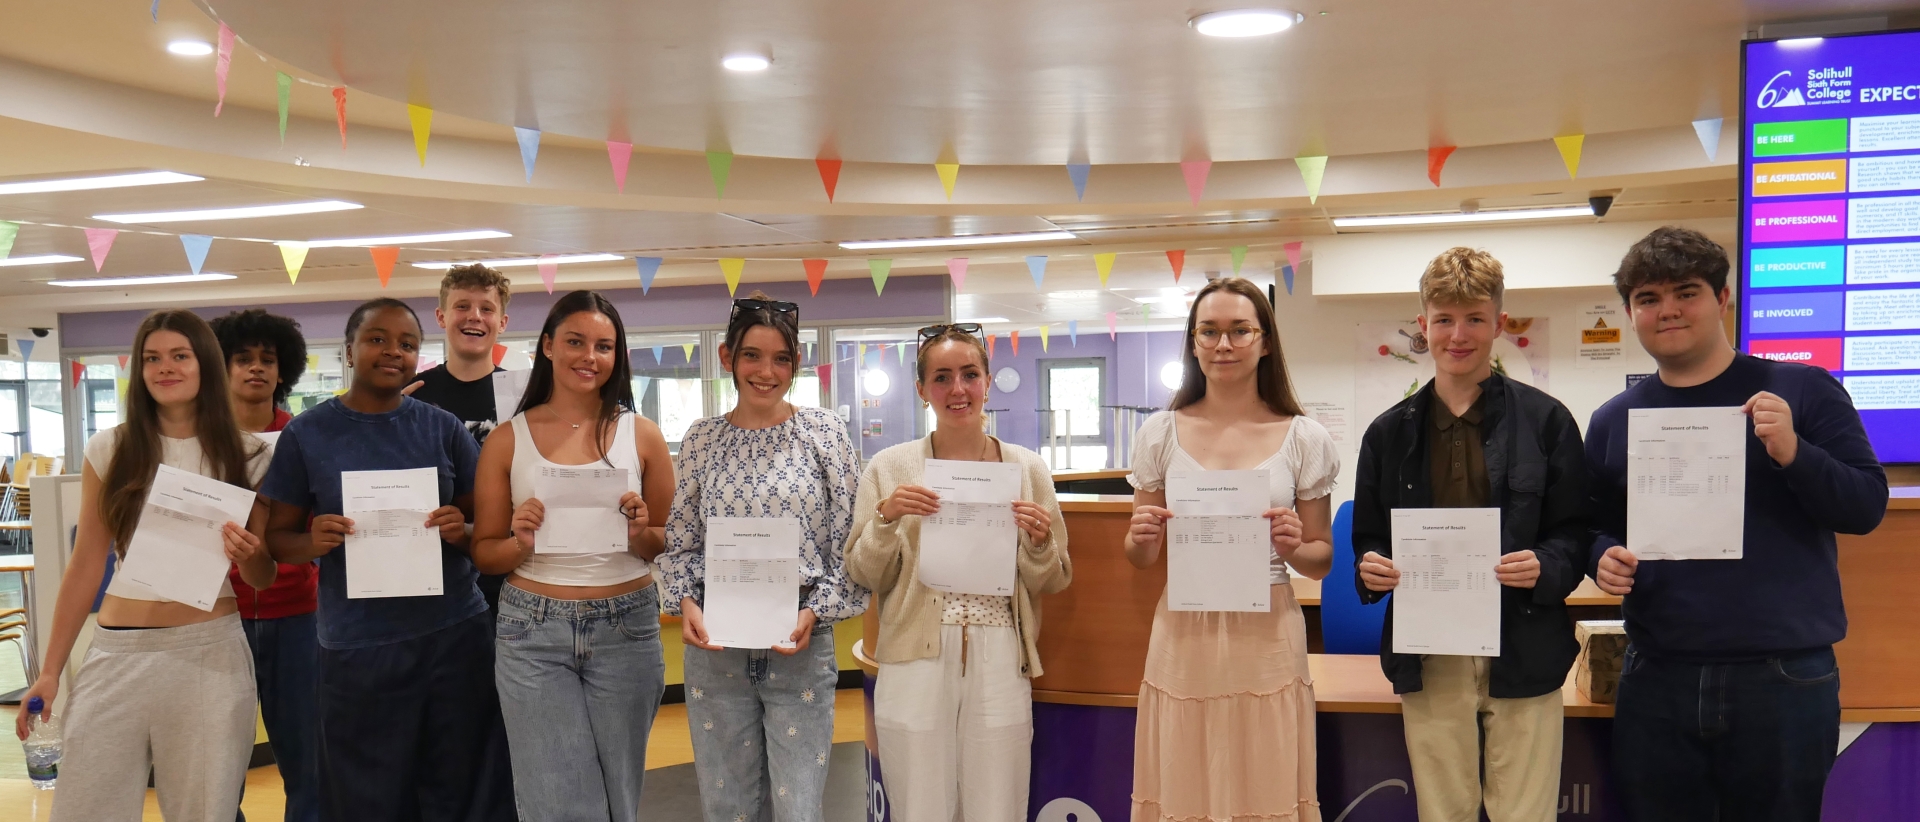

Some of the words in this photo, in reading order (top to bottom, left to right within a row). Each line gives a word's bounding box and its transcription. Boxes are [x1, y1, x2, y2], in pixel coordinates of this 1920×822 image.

[1808, 66, 1852, 80] Solihull
[1807, 87, 1851, 100] College
[1771, 135, 1794, 143] HERE
[1756, 175, 1767, 183] BE
[1770, 172, 1836, 182] ASPIRATIONAL
[1769, 215, 1838, 225] PROFESSIONAL
[1768, 262, 1826, 271] PRODUCTIVE
[1767, 309, 1814, 317] INVOLVED
[1766, 352, 1812, 360] ENGAGED
[183, 487, 203, 496] Statement
